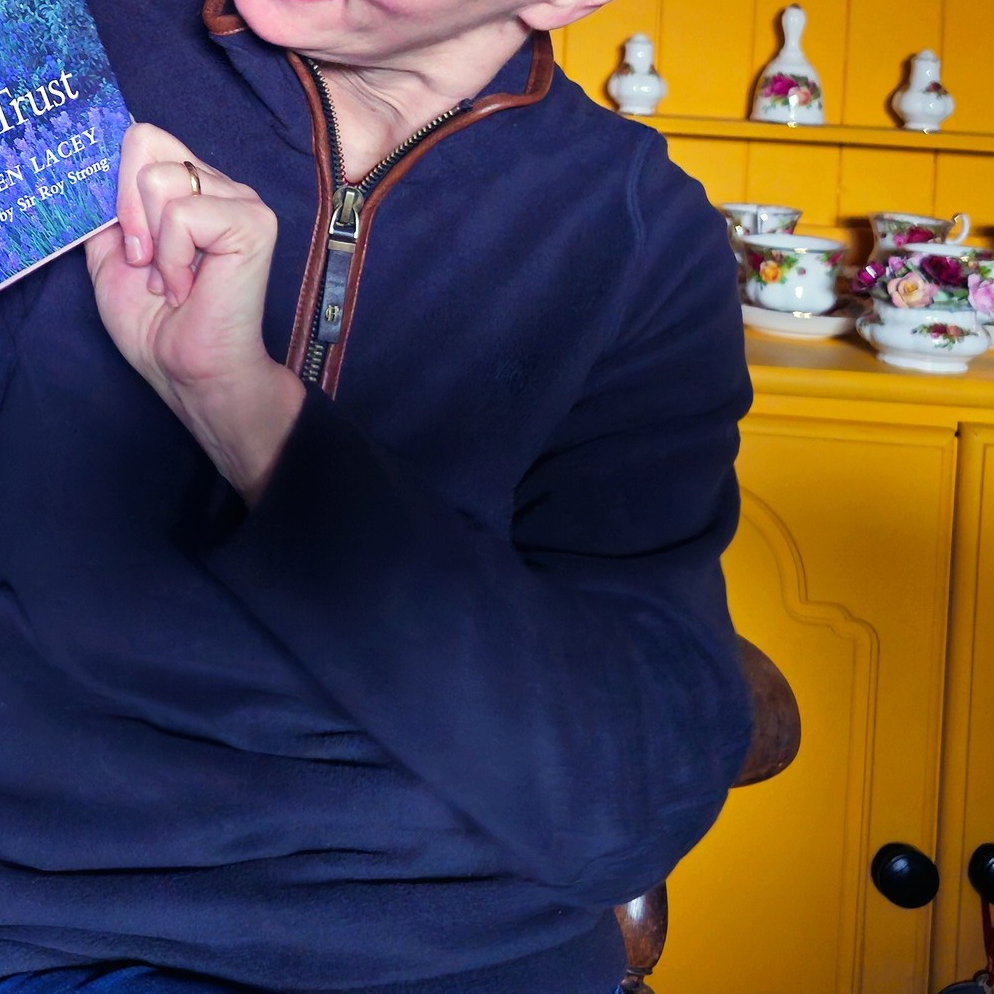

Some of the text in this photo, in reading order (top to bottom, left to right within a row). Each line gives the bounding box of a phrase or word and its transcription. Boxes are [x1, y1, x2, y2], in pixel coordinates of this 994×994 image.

[29, 127, 99, 174] LACEY
[17, 194, 36, 212] Sir
[38, 180, 66, 200] Roy
[67, 158, 110, 185] Strong
